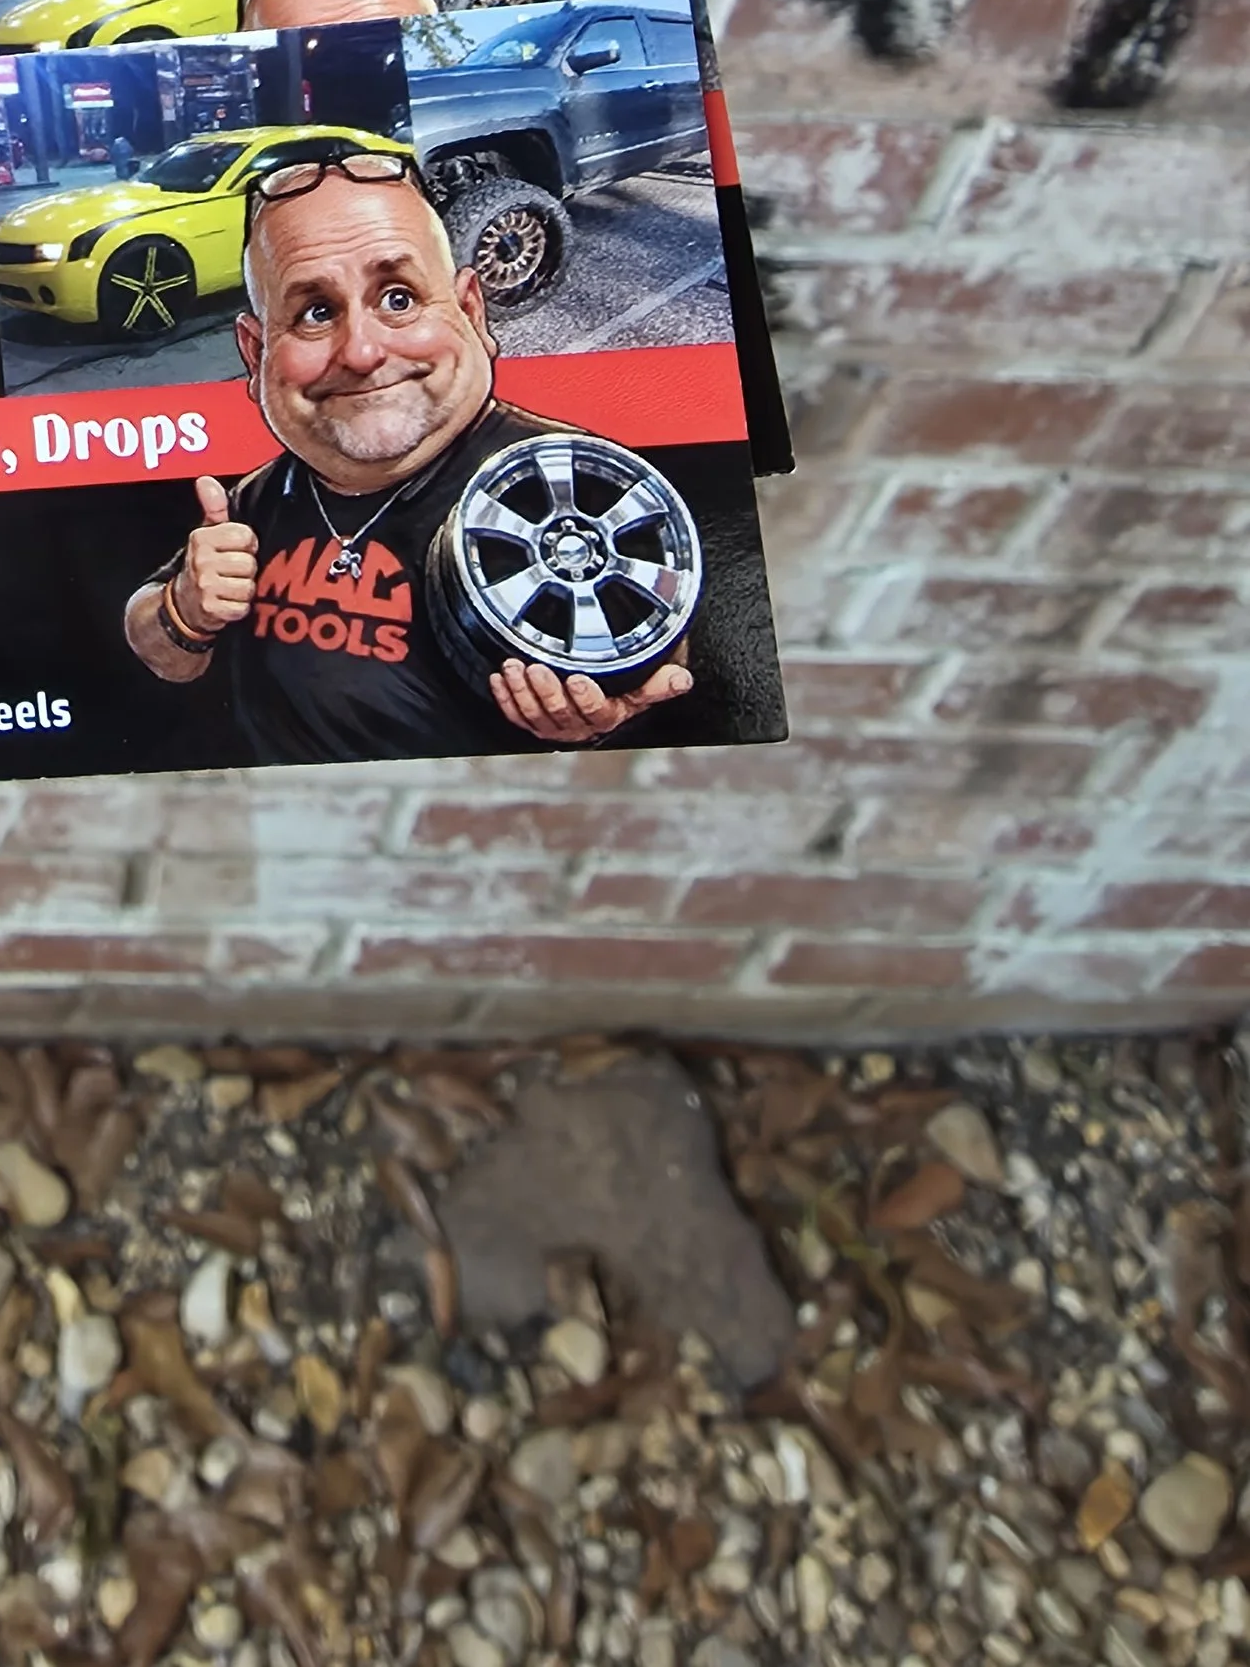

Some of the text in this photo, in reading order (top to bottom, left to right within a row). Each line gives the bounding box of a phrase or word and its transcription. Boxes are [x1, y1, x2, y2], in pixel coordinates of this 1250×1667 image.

[32, 410, 209, 470] Drops
[255, 536, 413, 623] MAC
[252, 602, 409, 663] TOOLS
